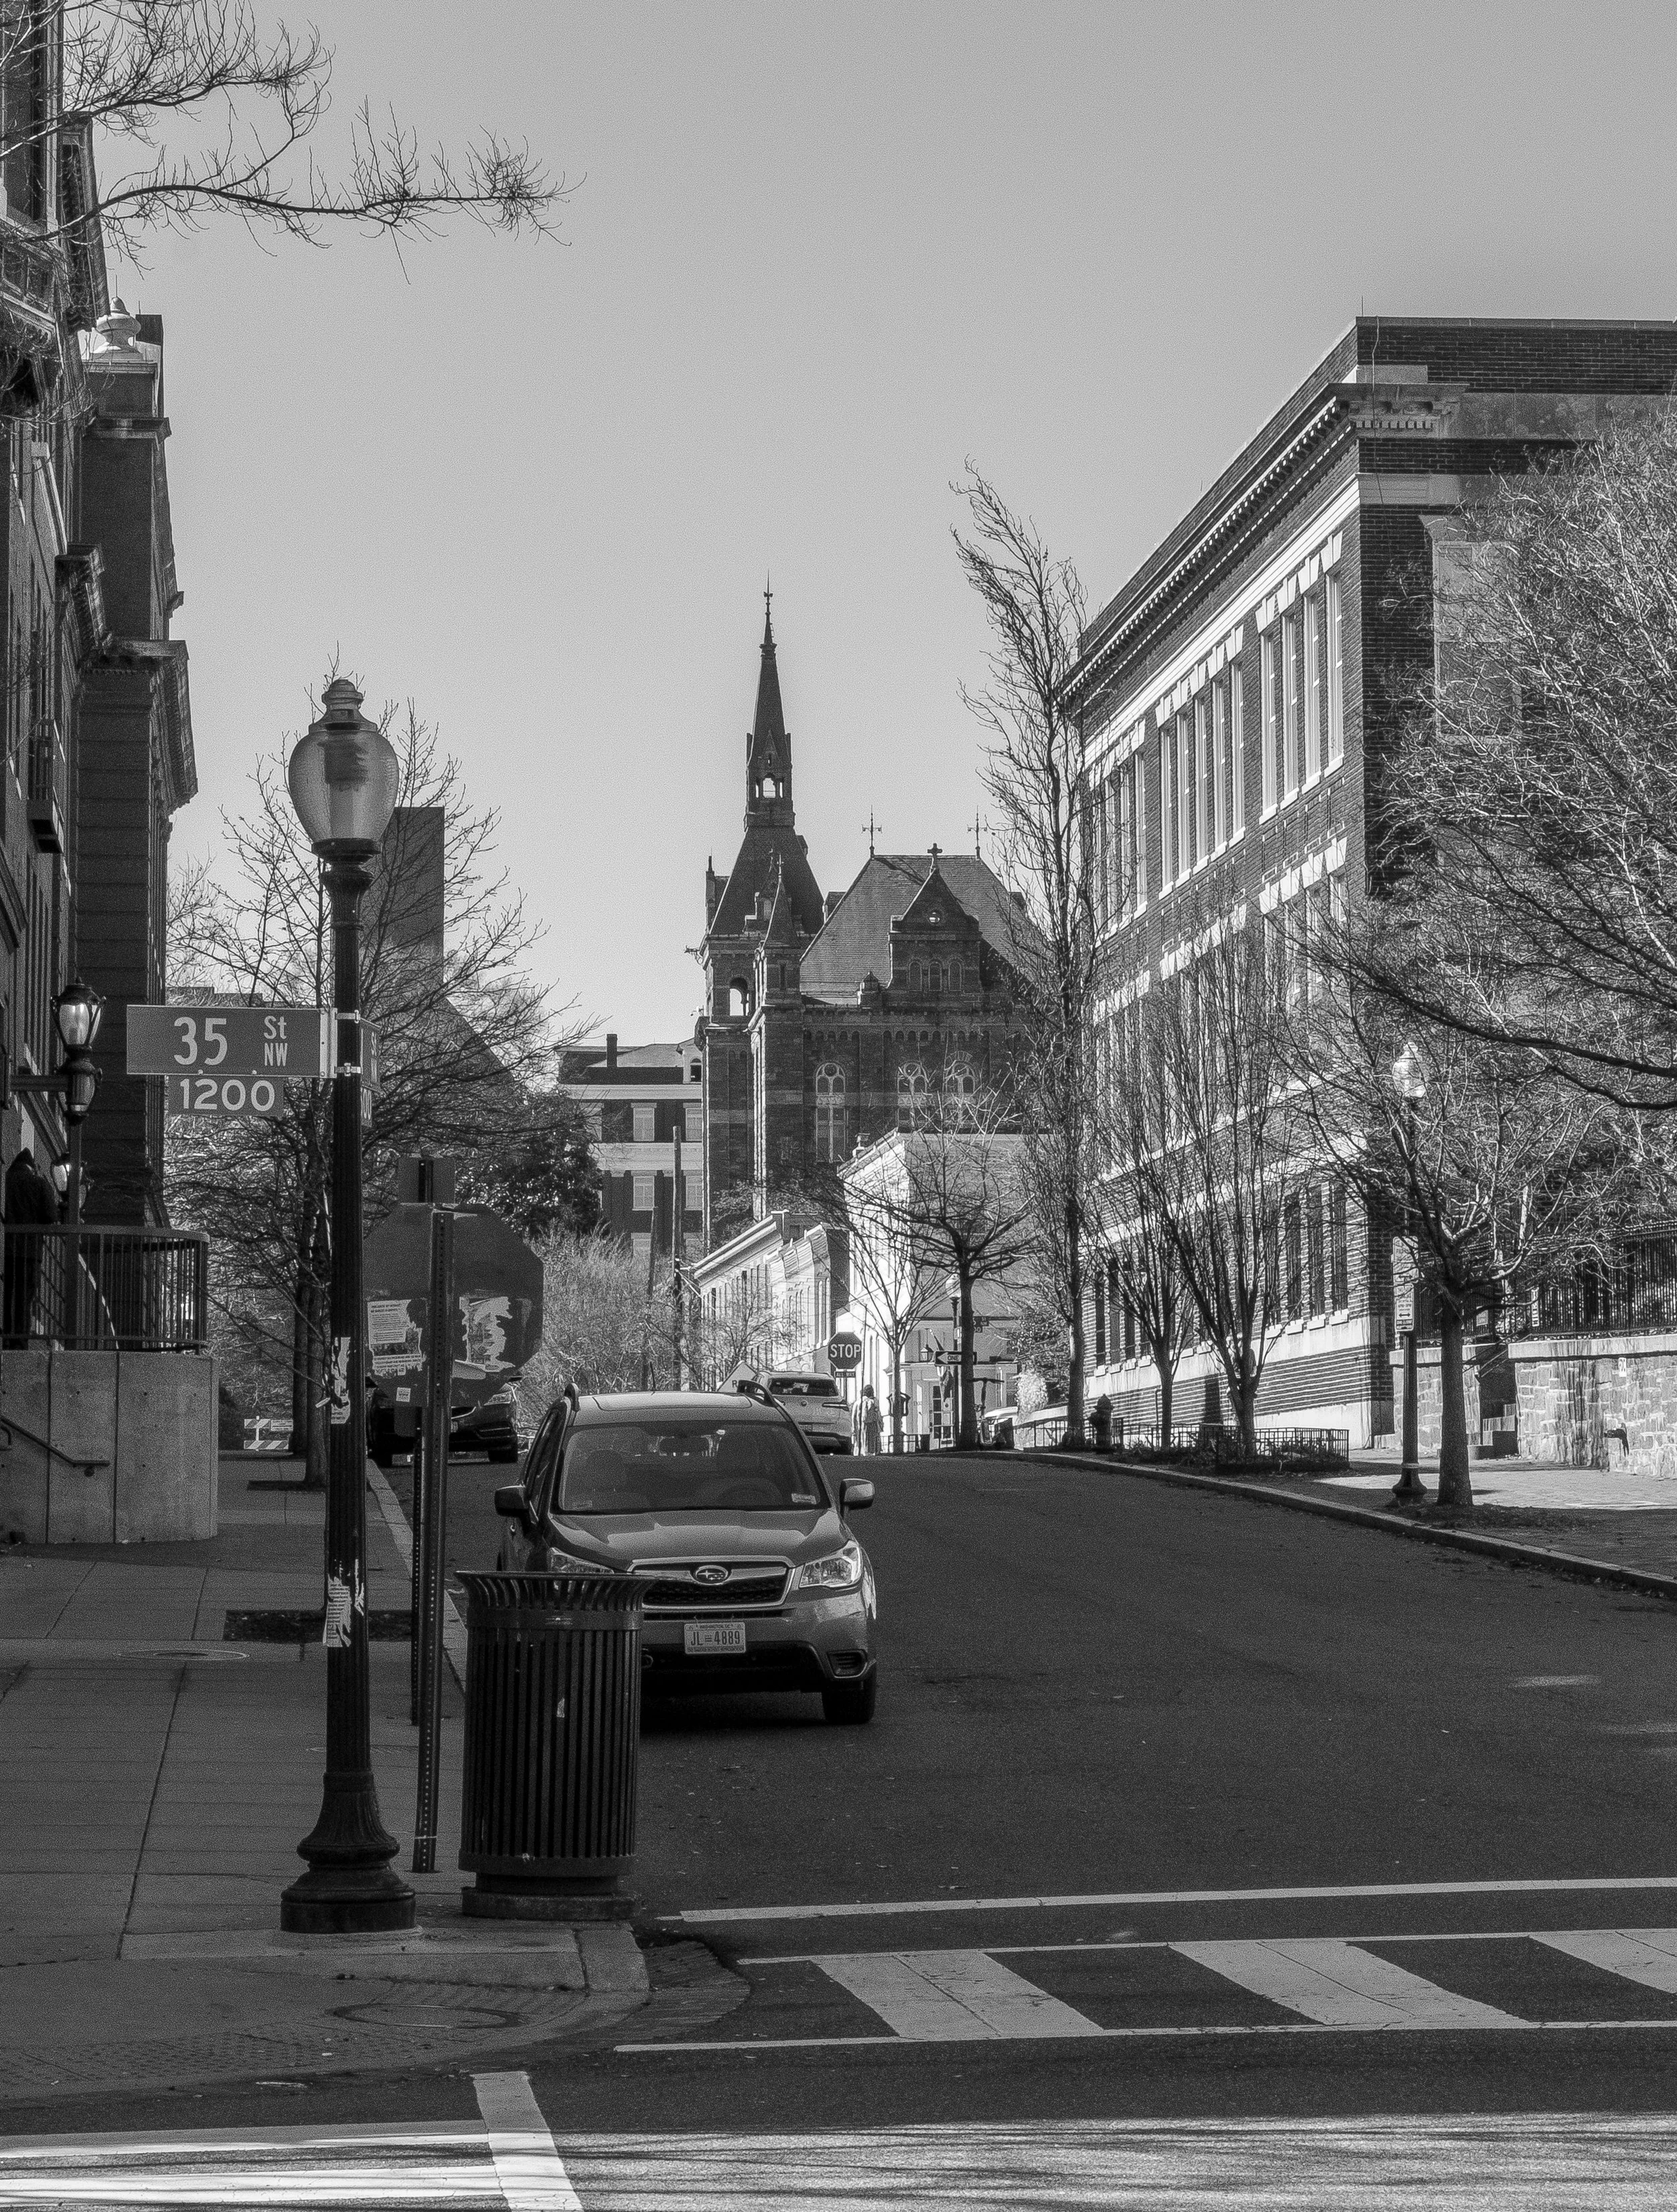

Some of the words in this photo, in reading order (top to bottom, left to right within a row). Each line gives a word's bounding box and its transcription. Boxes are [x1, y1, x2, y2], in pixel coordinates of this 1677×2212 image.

[263, 1015, 288, 1040] St
[173, 1016, 228, 1065] 35
[264, 1042, 288, 1067] NW
[179, 1078, 276, 1112] 1200
[830, 1343, 861, 1358] STOP
[714, 1630, 741, 1645] 4889
